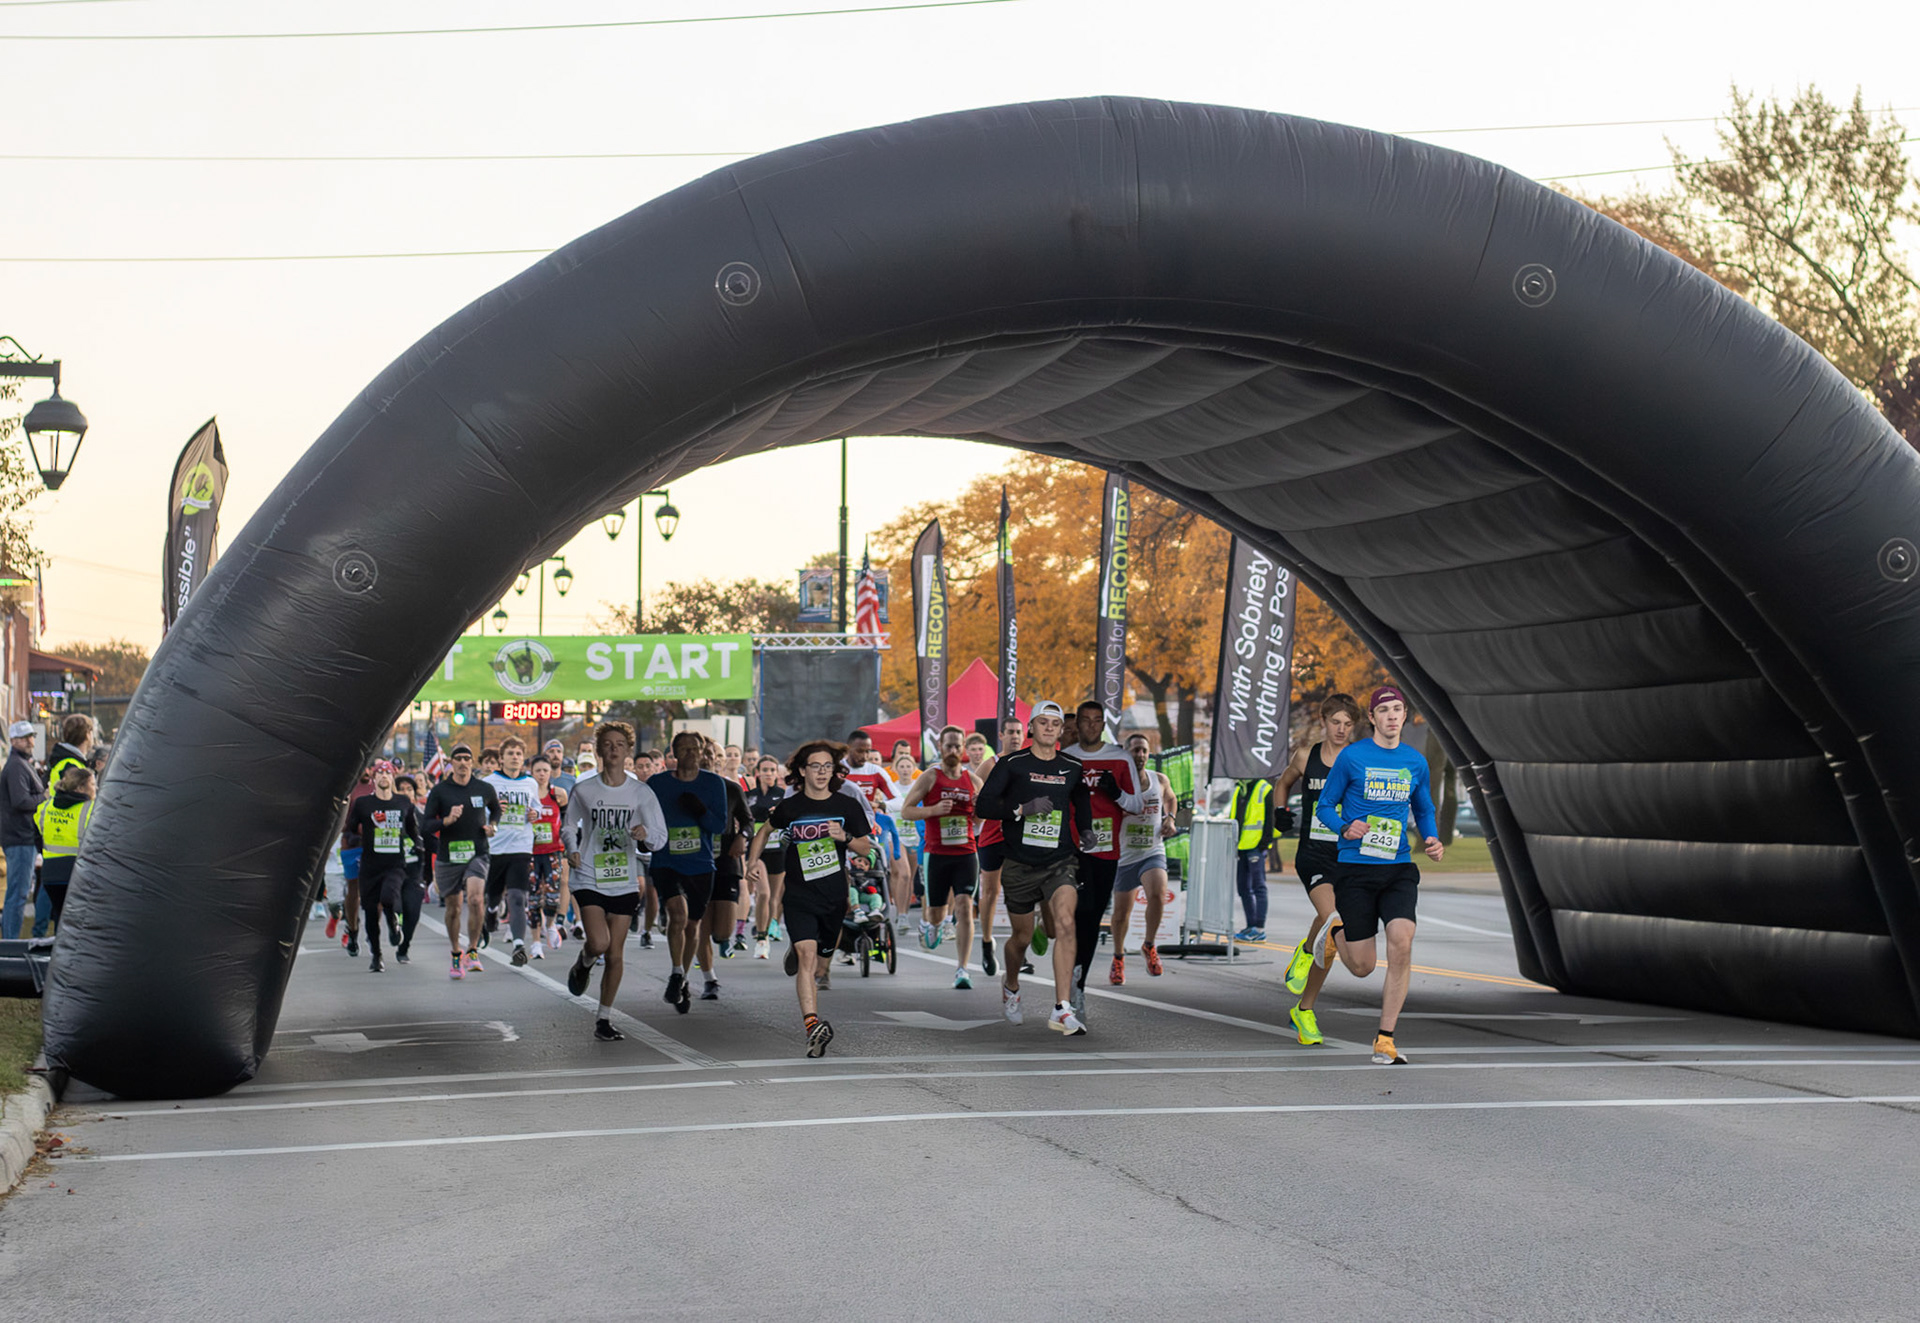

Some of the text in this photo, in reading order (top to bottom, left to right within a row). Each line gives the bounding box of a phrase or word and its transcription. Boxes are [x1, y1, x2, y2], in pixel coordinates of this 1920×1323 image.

[1235, 549, 1273, 660] Sobriety
[585, 642, 739, 680] START
[1251, 565, 1290, 767] Anything is Pos
[1368, 781, 1410, 792] ANN ARBOR
[1368, 789, 1410, 799] MARATHON
[51, 817, 68, 825] TEAM
[1031, 825, 1054, 835] 242
[676, 841, 694, 849] 221
[1370, 834, 1393, 846] 243
[807, 854, 831, 867] 303
[603, 868, 621, 877] 312
